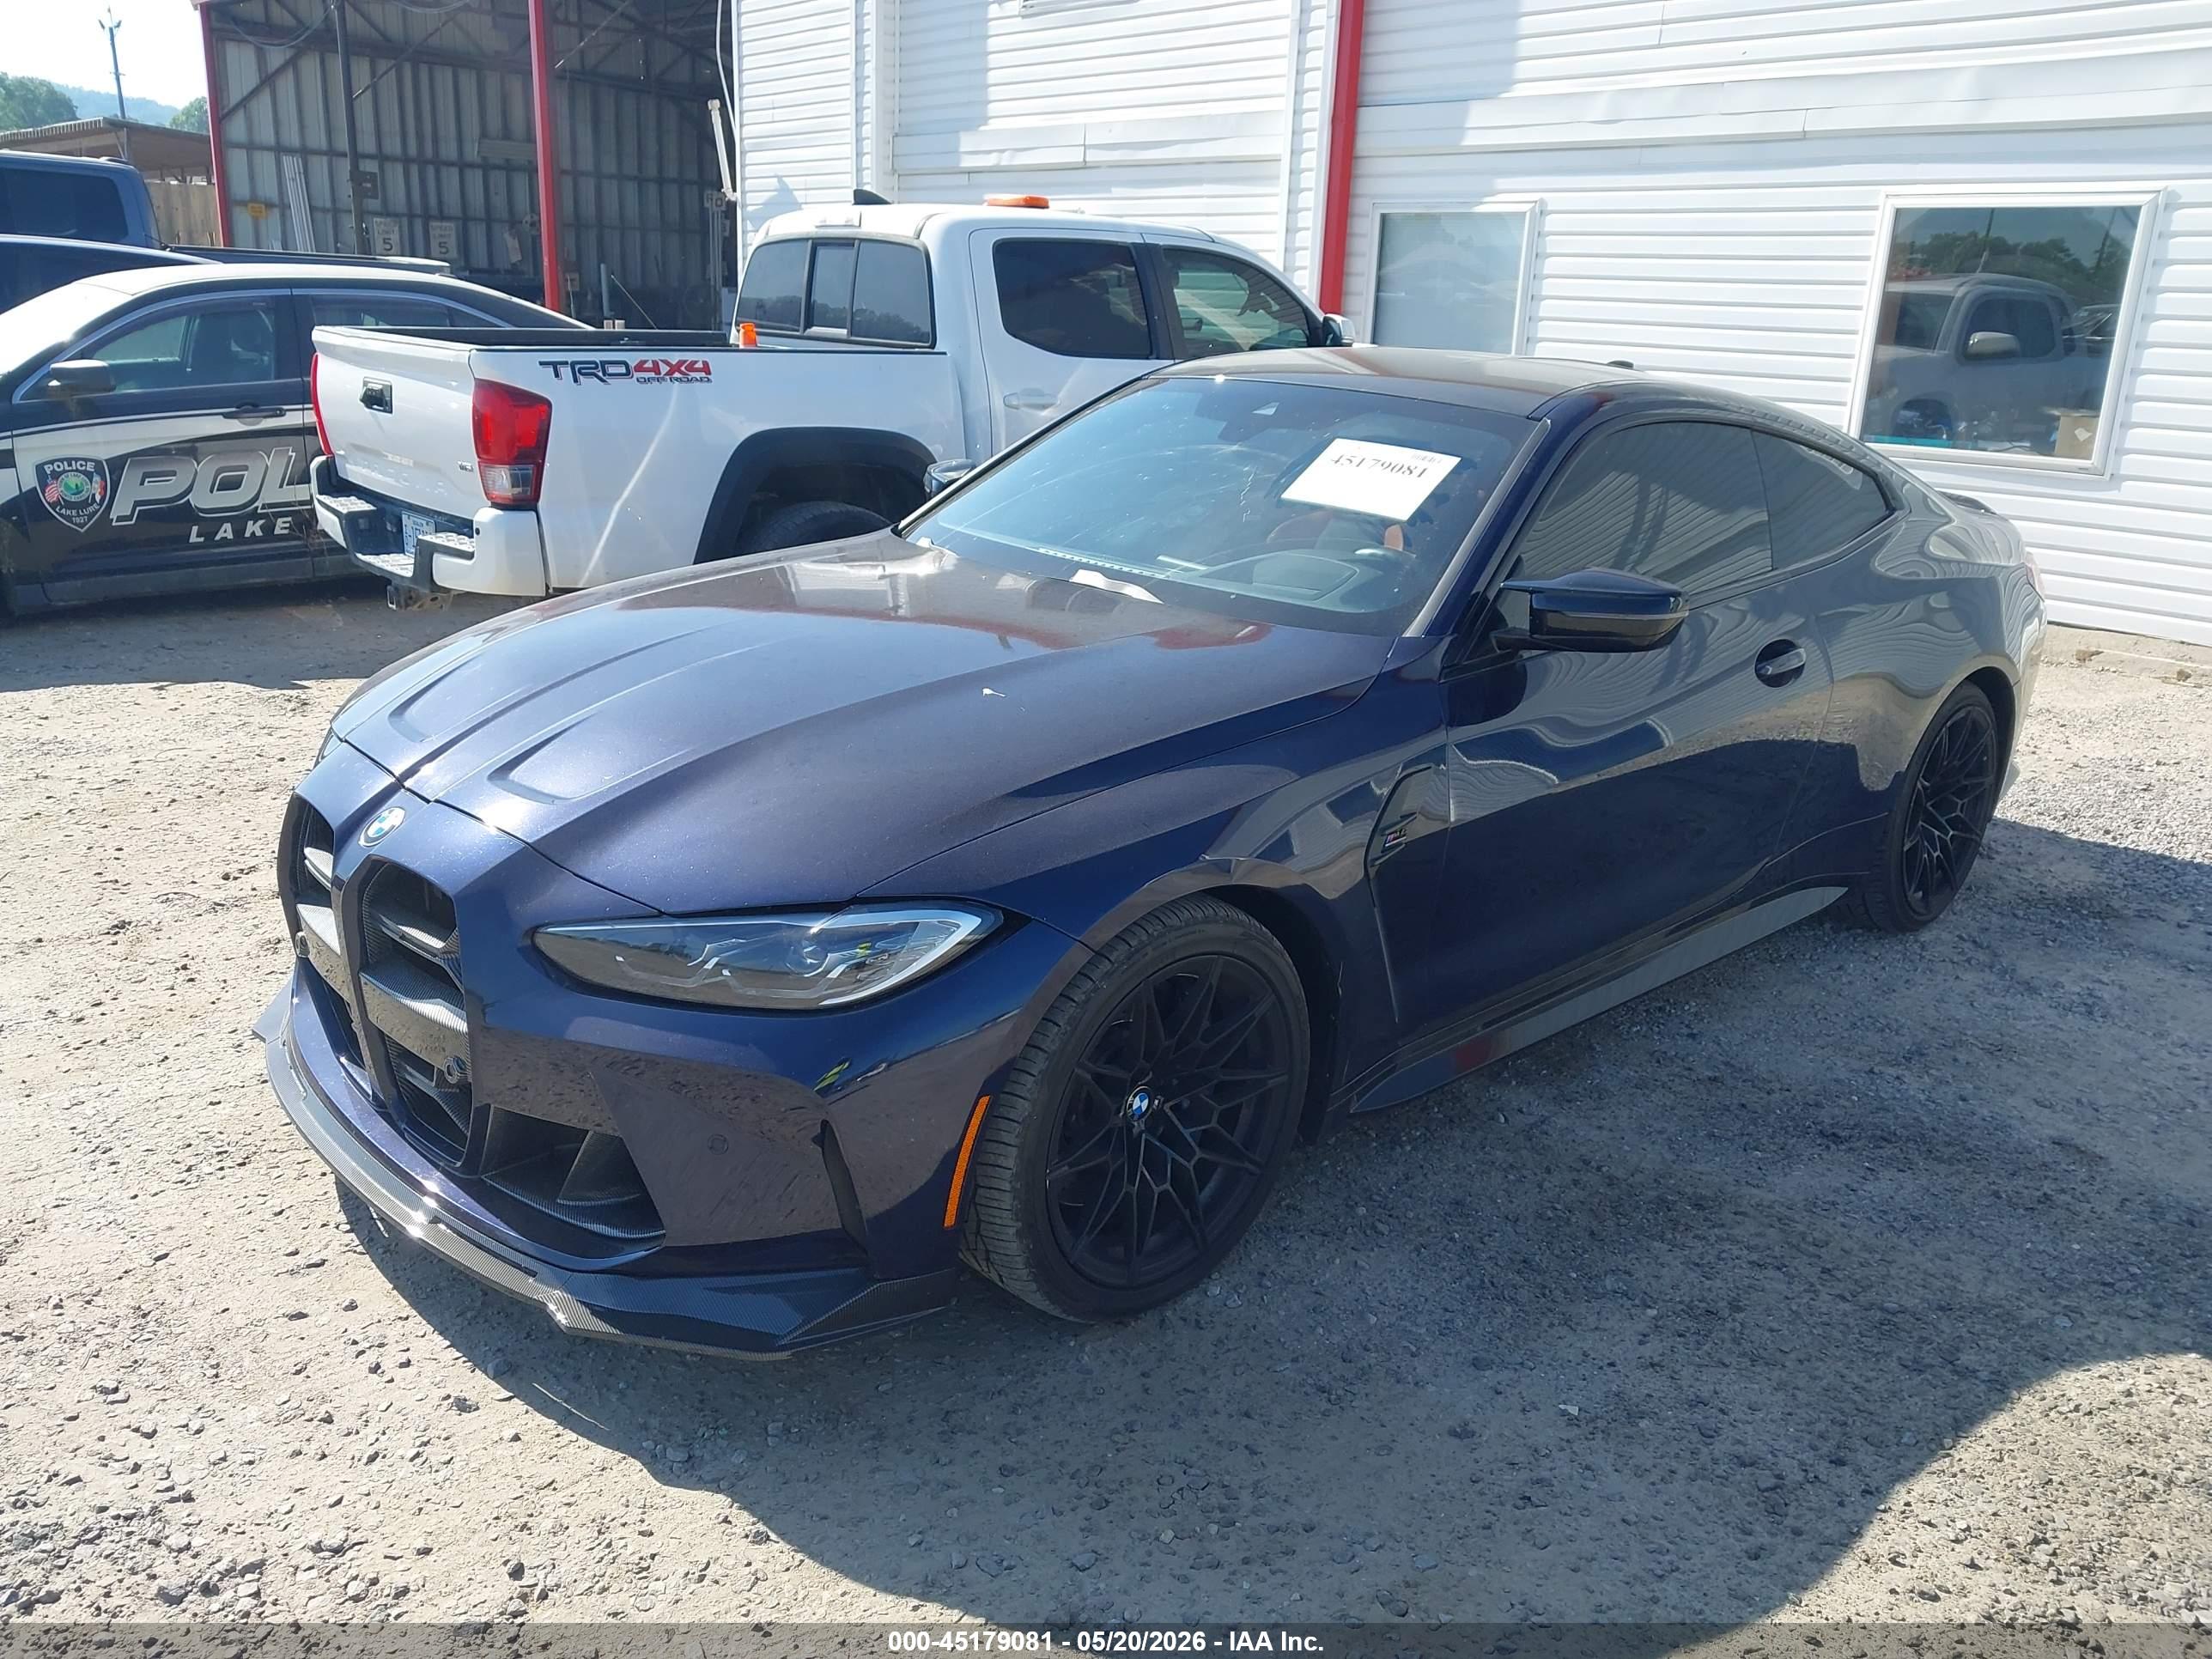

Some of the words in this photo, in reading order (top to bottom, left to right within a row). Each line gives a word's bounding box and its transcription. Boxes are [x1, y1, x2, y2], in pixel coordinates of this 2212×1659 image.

[383, 238, 392, 252] 5
[439, 241, 449, 255] 5
[538, 360, 634, 386] TRD
[44, 460, 95, 474] POLICE
[1330, 453, 1429, 478] 45179081
[56, 505, 77, 516] LAKE
[79, 502, 100, 515] LURE
[189, 517, 292, 543] LAKE
